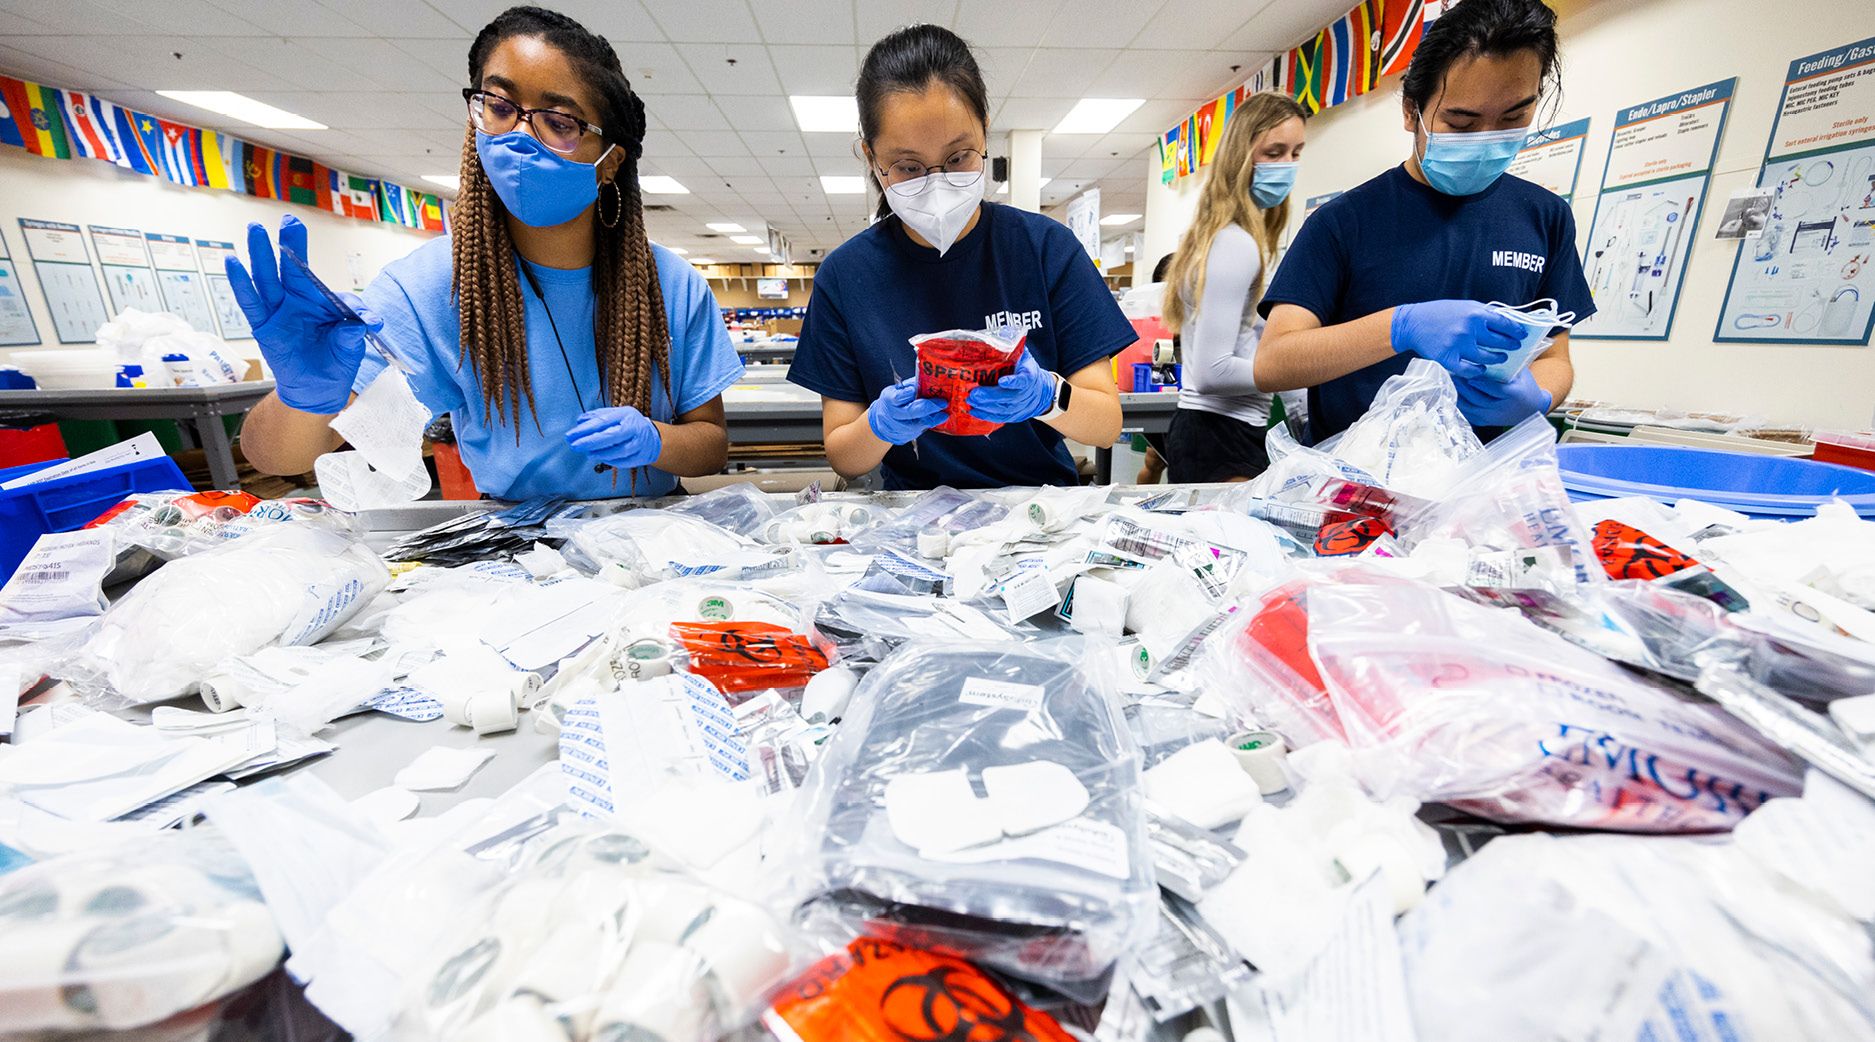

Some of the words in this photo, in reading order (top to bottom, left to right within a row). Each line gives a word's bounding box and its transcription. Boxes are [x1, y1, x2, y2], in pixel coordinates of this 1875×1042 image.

[1808, 80, 1827, 91] feeding
[1828, 76, 1843, 86] pump
[1844, 73, 1856, 81] sets
[1819, 84, 1838, 95] feeding
[1839, 80, 1855, 90] tubes
[1628, 88, 1718, 121] Endo/Lapro/Stapler
[1832, 119, 1854, 129] Sterile
[1855, 116, 1869, 125] only
[1492, 250, 1545, 273] MEMBER
